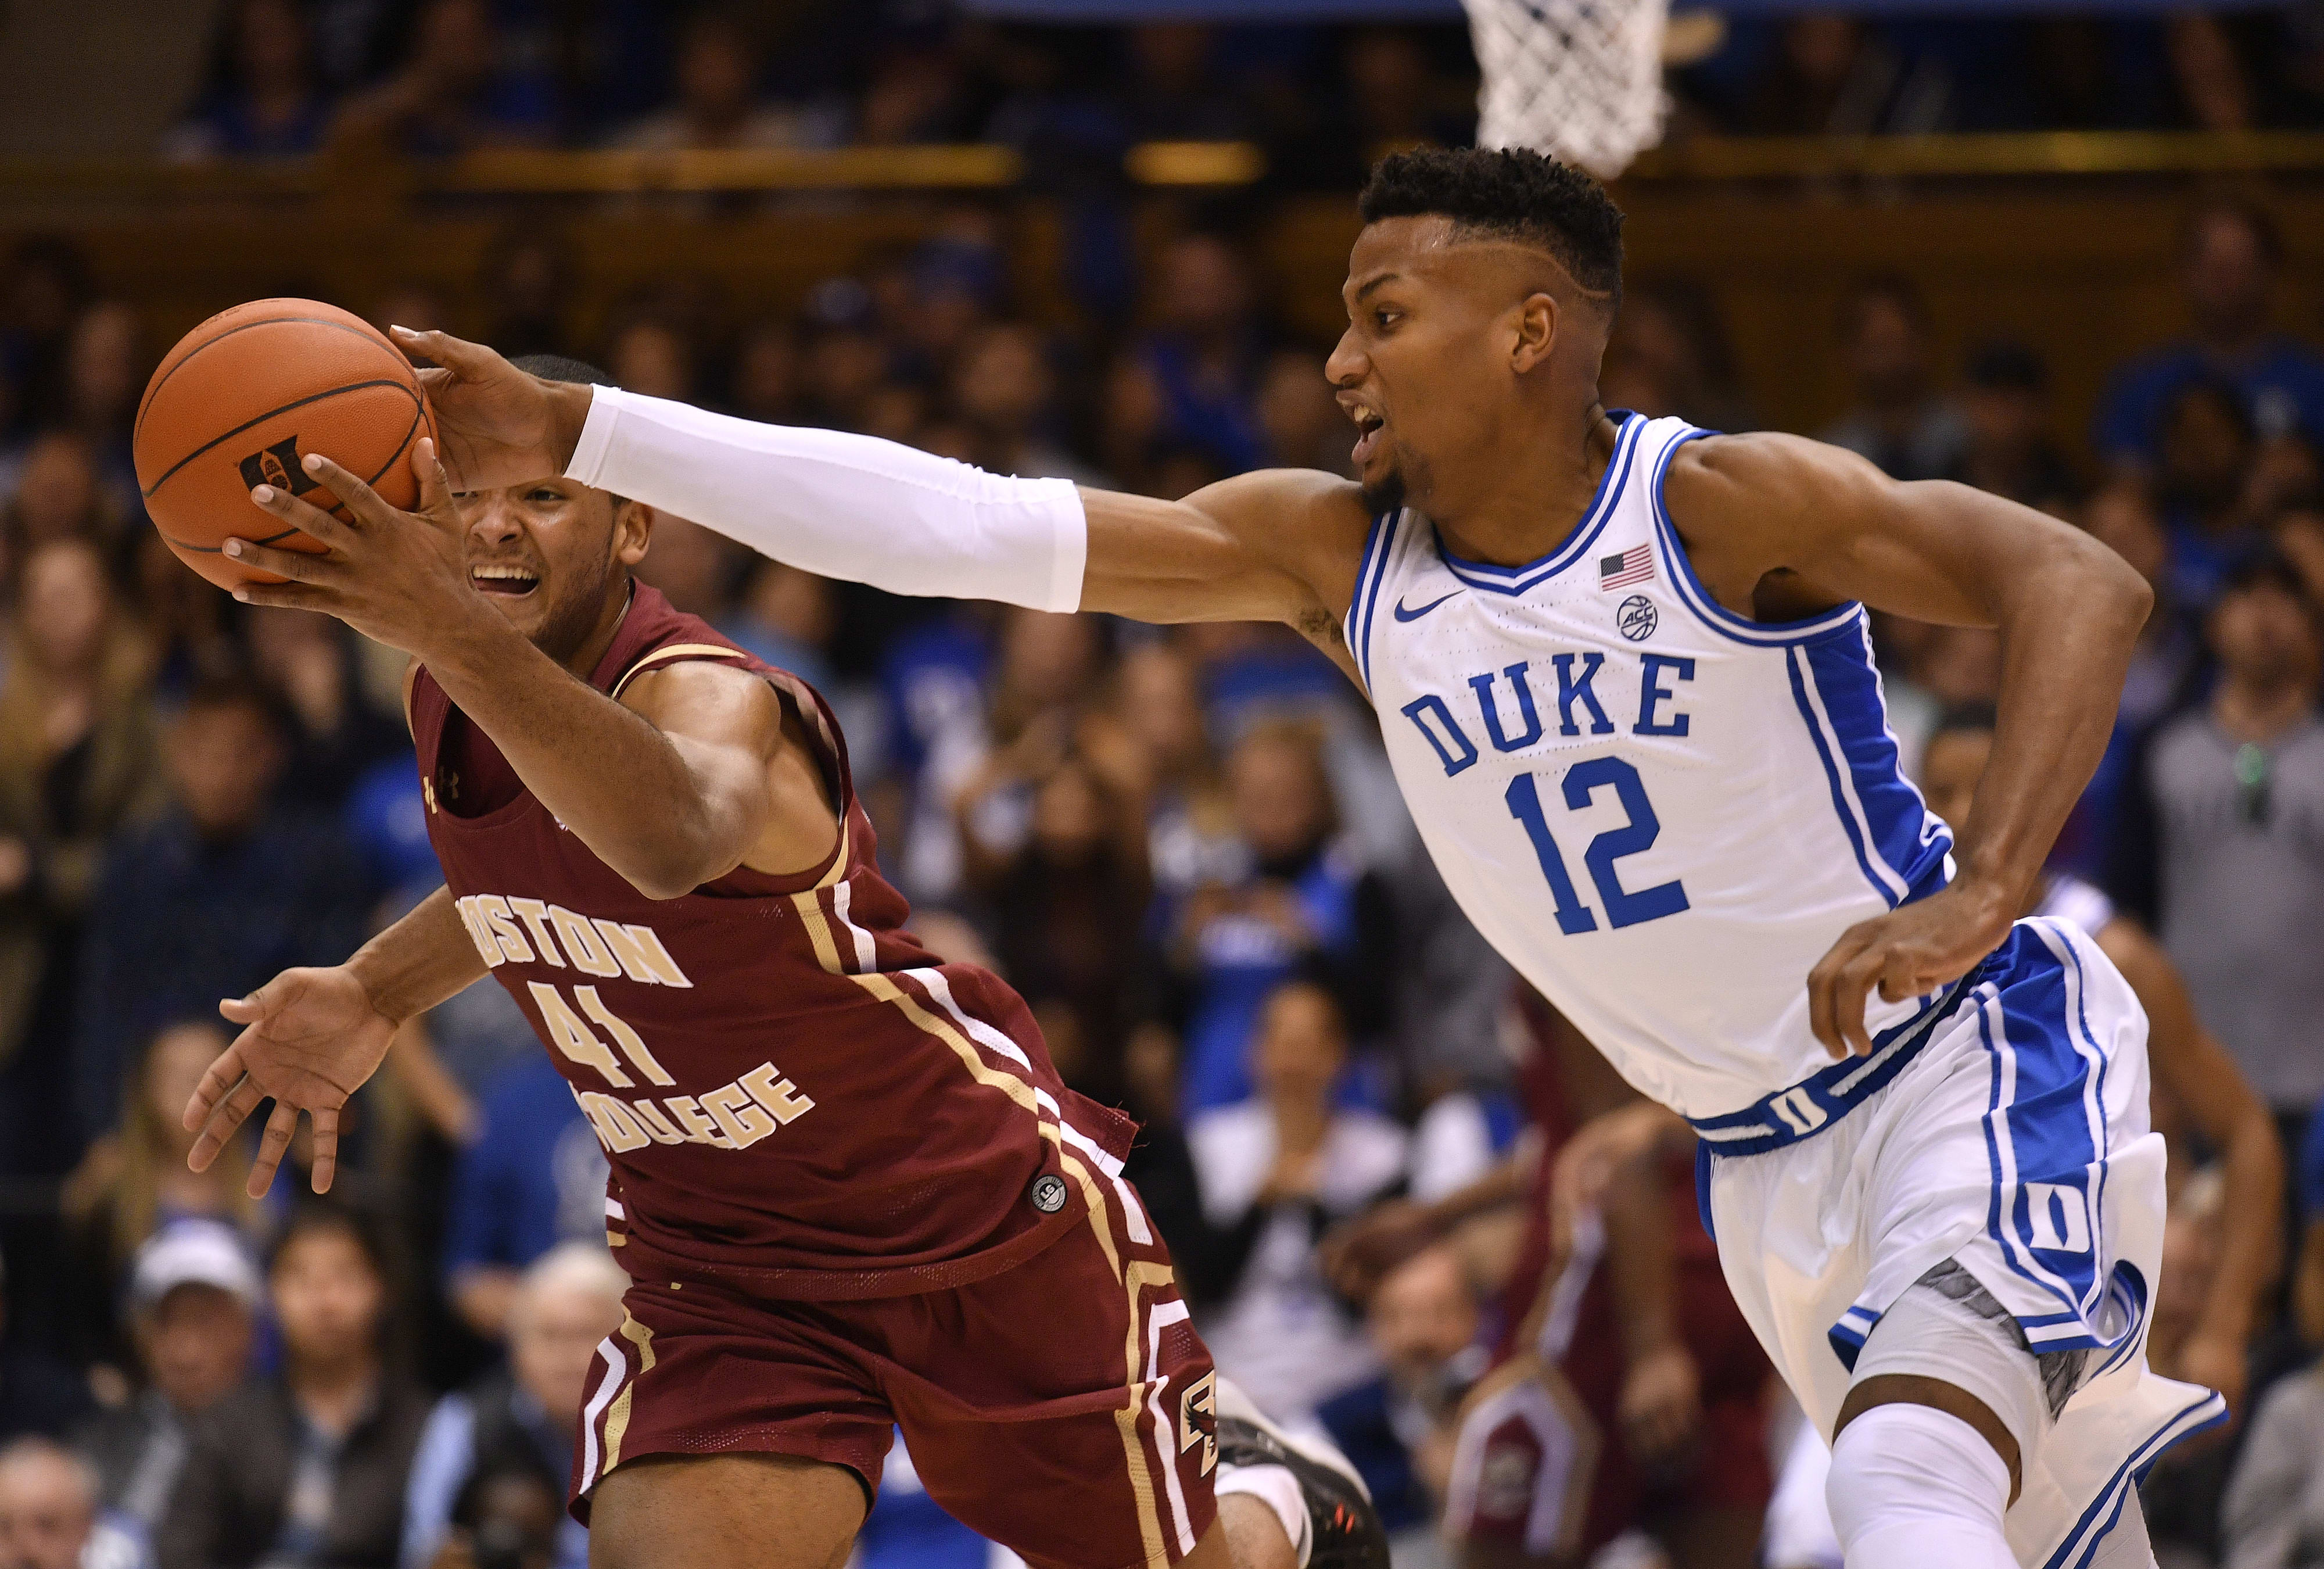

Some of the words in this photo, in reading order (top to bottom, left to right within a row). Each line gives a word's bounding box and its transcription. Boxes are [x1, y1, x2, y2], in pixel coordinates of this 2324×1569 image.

[1623, 604, 1653, 625] ACC
[1400, 652, 1695, 778] DUKE
[1505, 756, 1690, 936] 12
[455, 893, 694, 988] OSTON
[527, 980, 677, 1088] 41
[568, 1061, 816, 1154] OLLEGE
